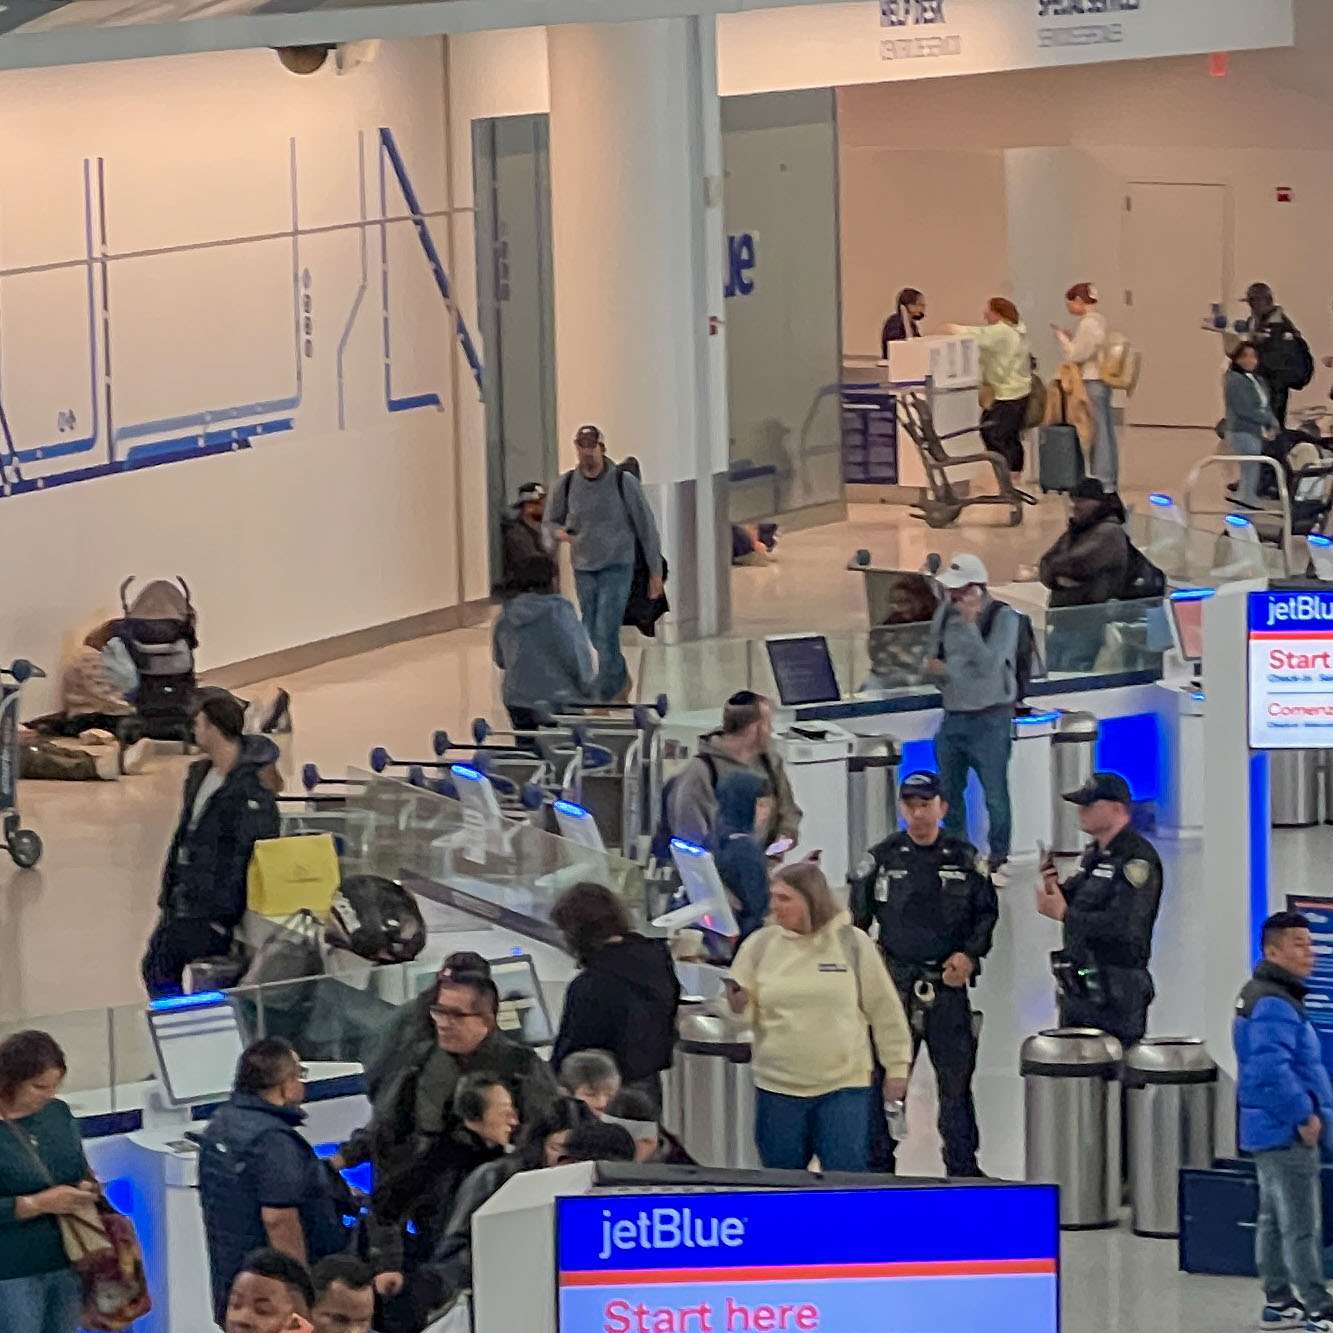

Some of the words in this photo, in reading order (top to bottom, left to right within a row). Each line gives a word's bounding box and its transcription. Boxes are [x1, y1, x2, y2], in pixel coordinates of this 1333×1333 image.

[1269, 649, 1331, 670] Start
[598, 1207, 745, 1260] jetBlue
[725, 1297, 820, 1332] here
